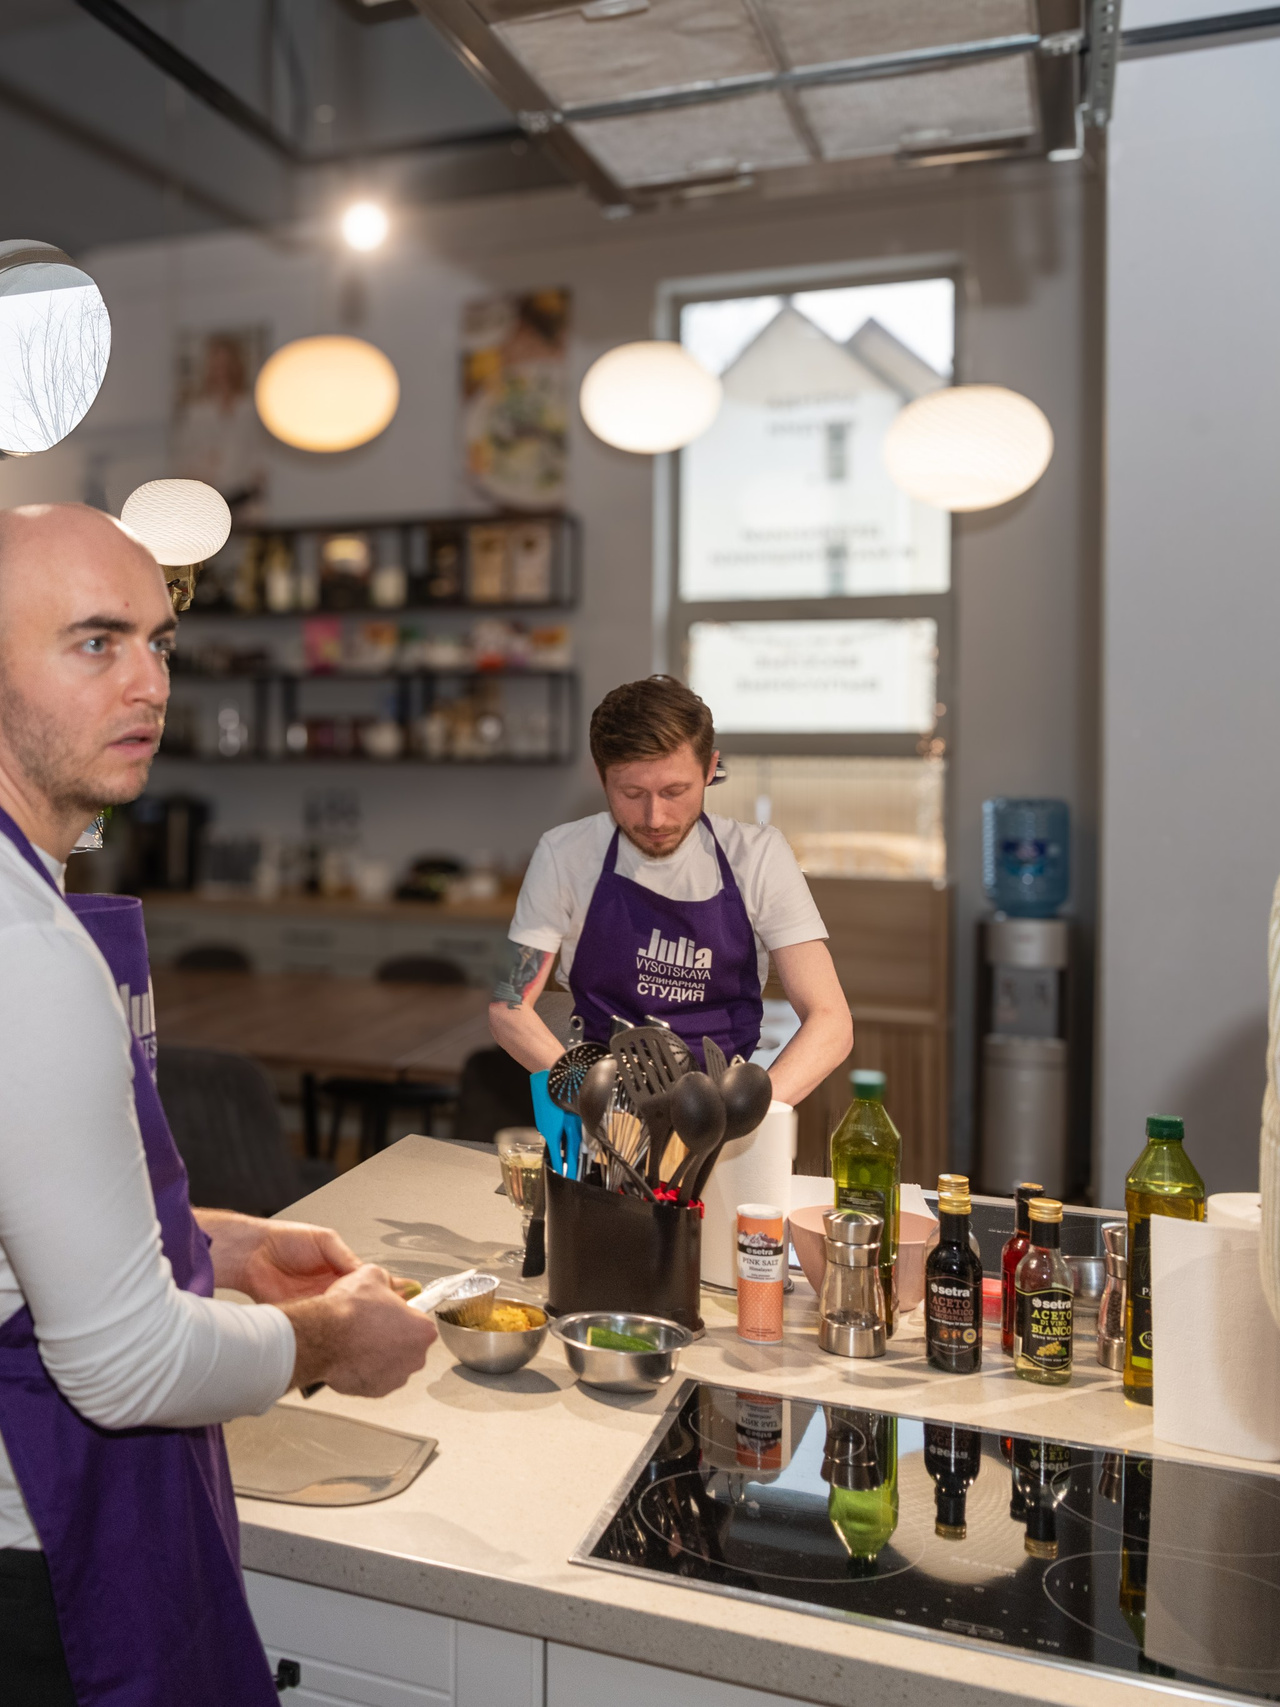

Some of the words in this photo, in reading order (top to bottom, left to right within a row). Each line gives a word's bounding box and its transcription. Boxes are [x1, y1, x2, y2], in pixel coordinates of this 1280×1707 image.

[637, 928, 712, 969] Julia
[636, 957, 711, 980] VYSOTSKAYA
[639, 974, 705, 990] КУЛИНАРНАЯ
[637, 982, 705, 1003] СТУДИЯ
[742, 1256, 760, 1266] PINK
[938, 1286, 970, 1298] setra
[932, 1296, 971, 1309] ACETO
[1031, 1309, 1072, 1320] ACETO
[1031, 1323, 1072, 1336] BIANCO
